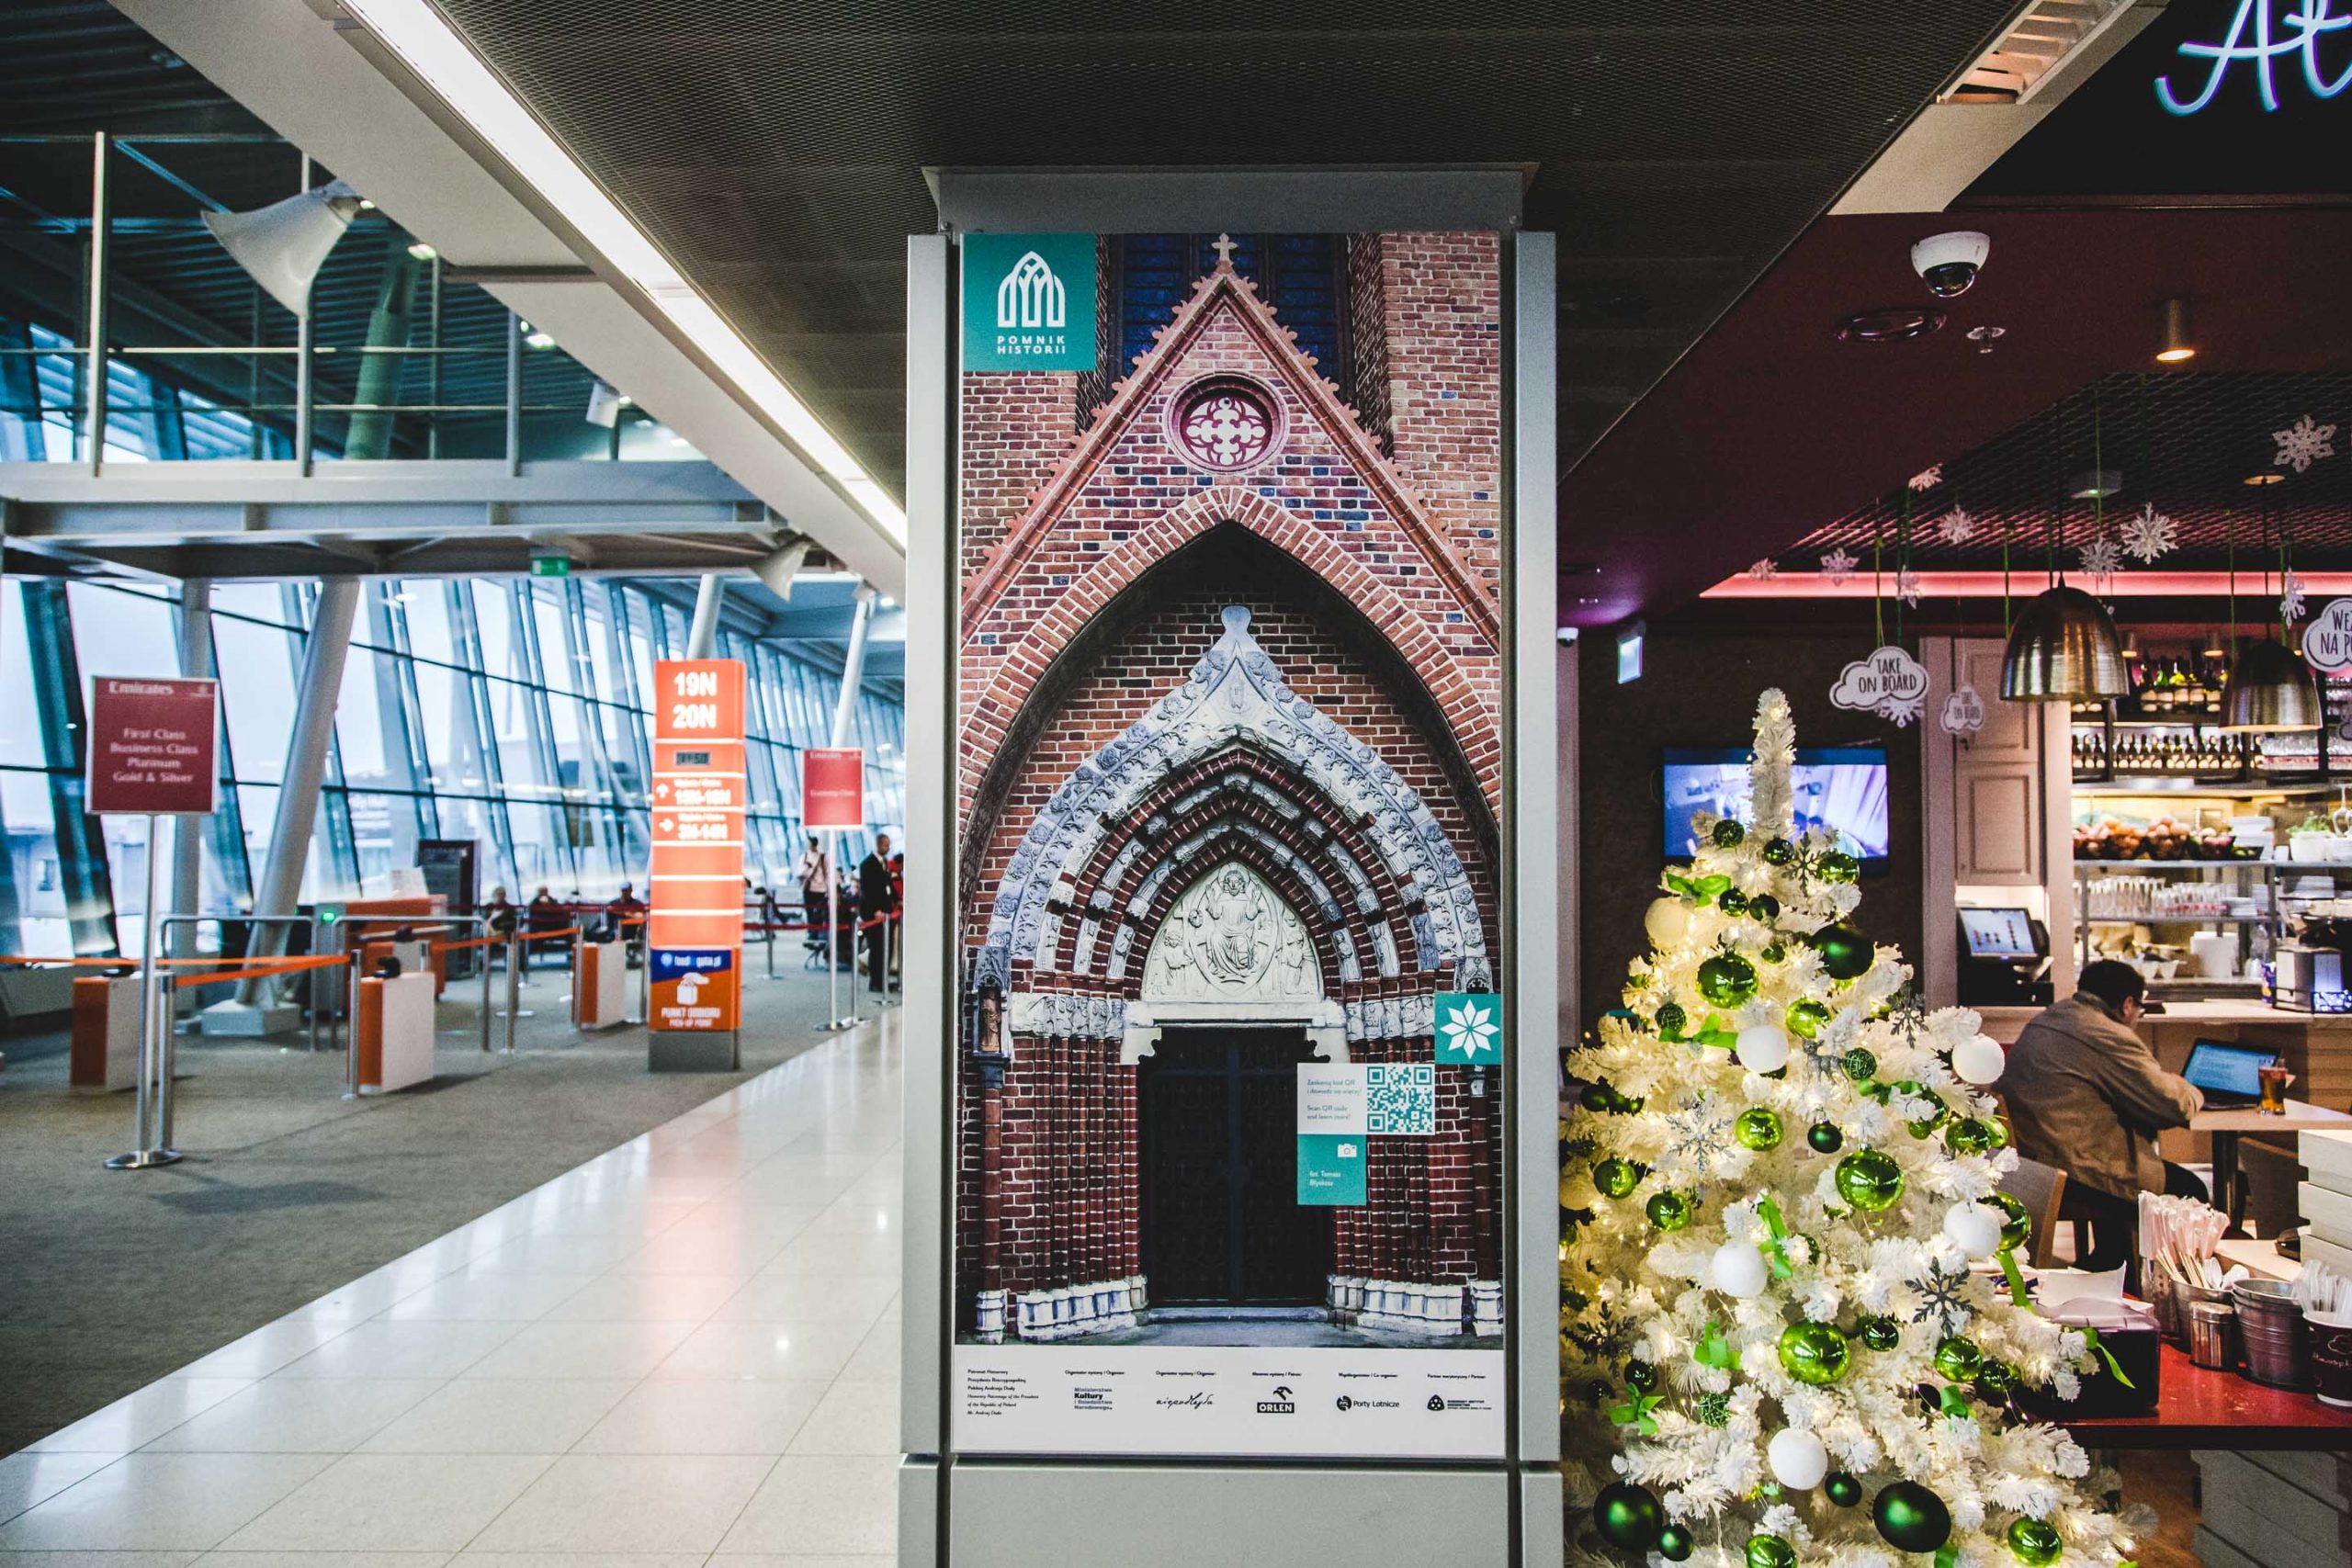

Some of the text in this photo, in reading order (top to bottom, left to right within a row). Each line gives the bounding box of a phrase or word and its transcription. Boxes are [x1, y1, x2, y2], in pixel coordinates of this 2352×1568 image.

[997, 335, 1065, 344] POMNIK
[997, 345, 1066, 355] HISTORII
[2333, 610, 2352, 631] WE
[2321, 633, 2352, 656] NA P
[1876, 658, 1903, 674] TAKE
[108, 680, 175, 695] Emirates
[673, 671, 718, 697] 19N
[1859, 674, 1917, 694] ON BOARD
[673, 704, 718, 729] 20N
[123, 727, 187, 740] First Class
[109, 741, 199, 755] Business Class
[126, 756, 182, 769] Platinum
[112, 771, 195, 783] Gold & Silver
[1074, 1393, 1103, 1401] Kultury
[1259, 1404, 1293, 1412] ORLEN
[1352, 1400, 1370, 1408] Porty
[1372, 1400, 1400, 1408] Lotnicze
